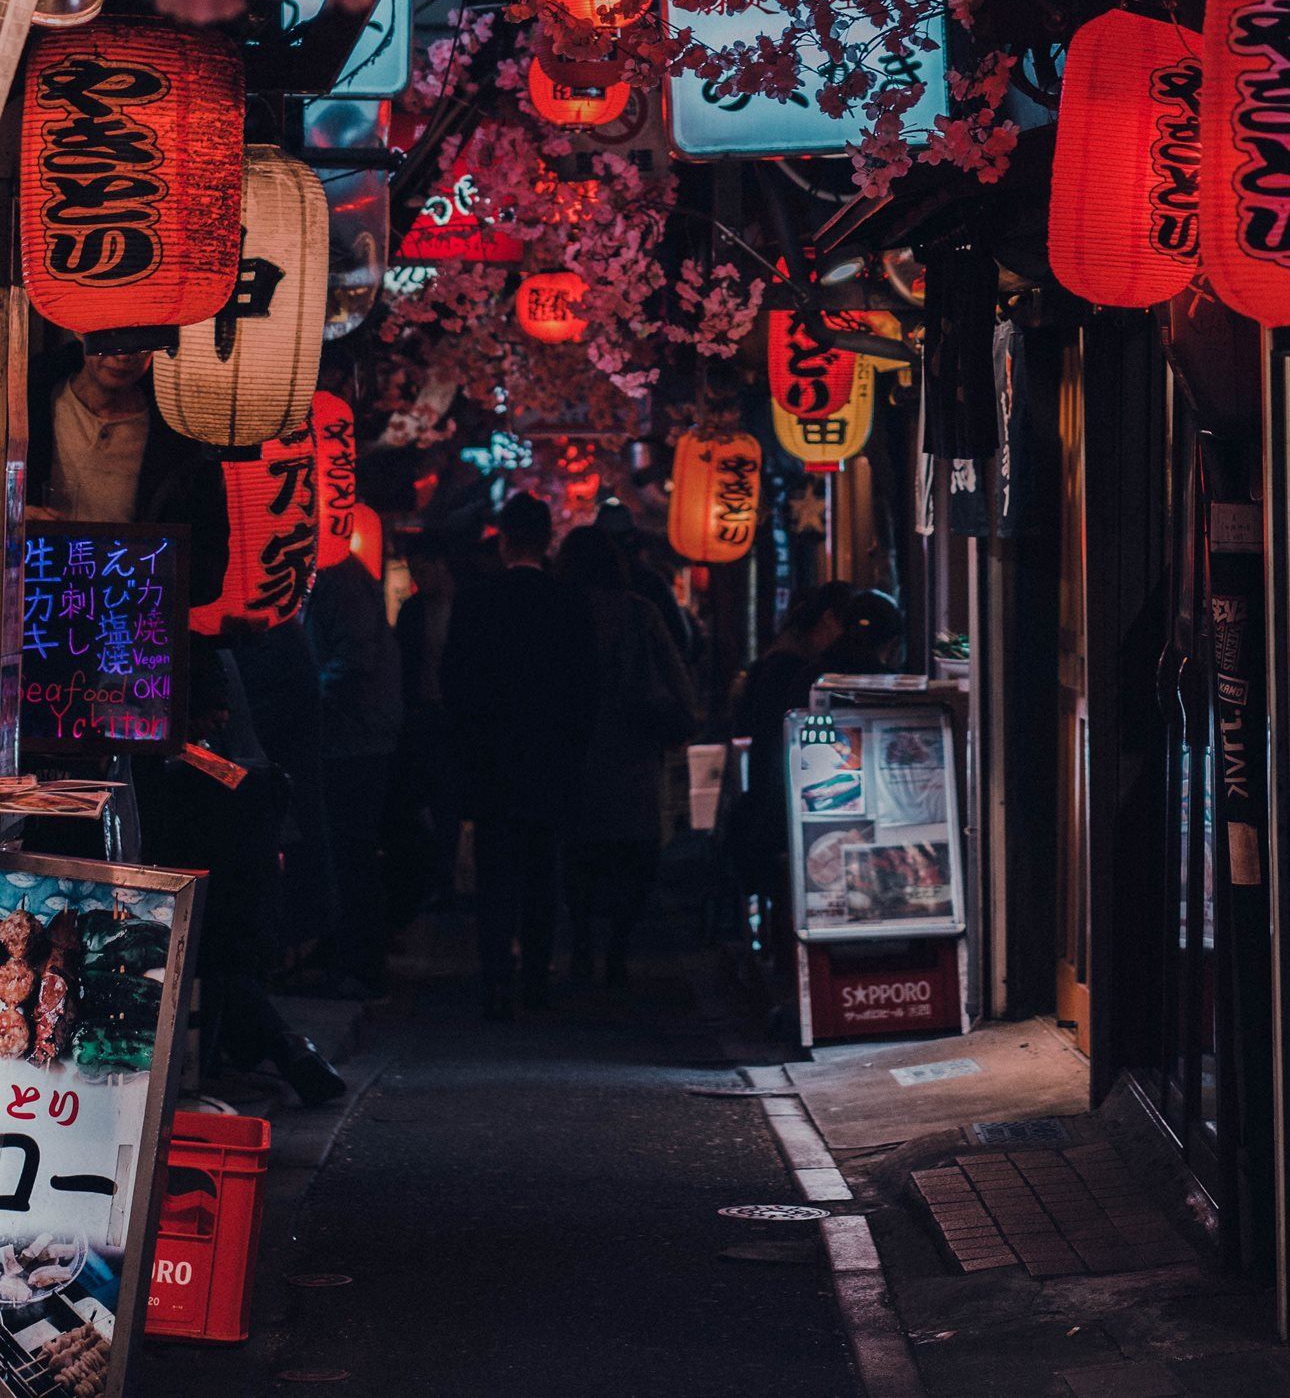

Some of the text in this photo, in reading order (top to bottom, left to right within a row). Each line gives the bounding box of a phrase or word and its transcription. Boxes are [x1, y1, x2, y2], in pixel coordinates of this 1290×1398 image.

[39, 57, 166, 284] やきとり
[22, 537, 62, 660] 生カキ
[58, 540, 97, 656] 馬刺し
[94, 539, 137, 674] えび塩焼
[133, 537, 170, 646] イカ焼
[132, 647, 171, 669] Vegan
[151, 1258, 193, 1286] RO
